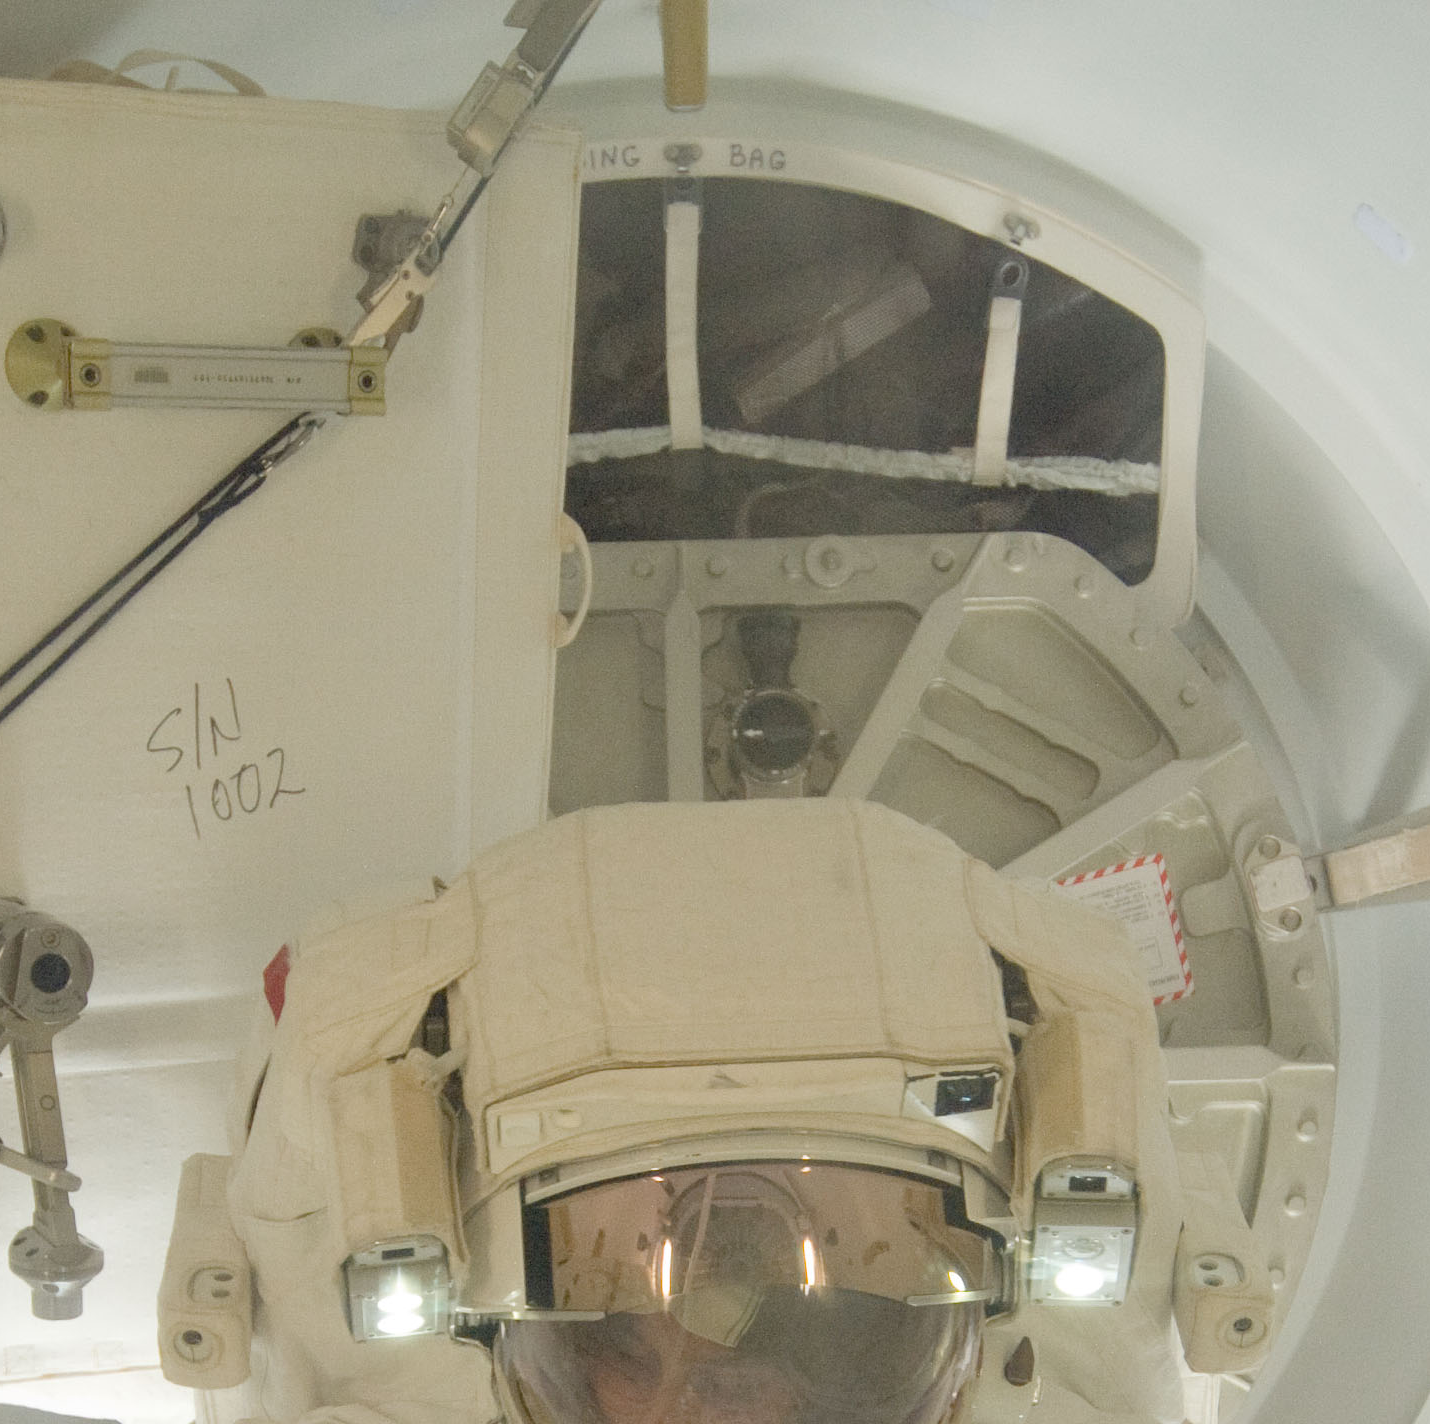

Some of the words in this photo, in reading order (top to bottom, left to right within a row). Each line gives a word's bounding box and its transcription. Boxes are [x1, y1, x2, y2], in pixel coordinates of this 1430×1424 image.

[582, 145, 640, 170] ING
[729, 143, 787, 170] BAG
[147, 677, 242, 770] S/N
[185, 747, 307, 841] 1002
